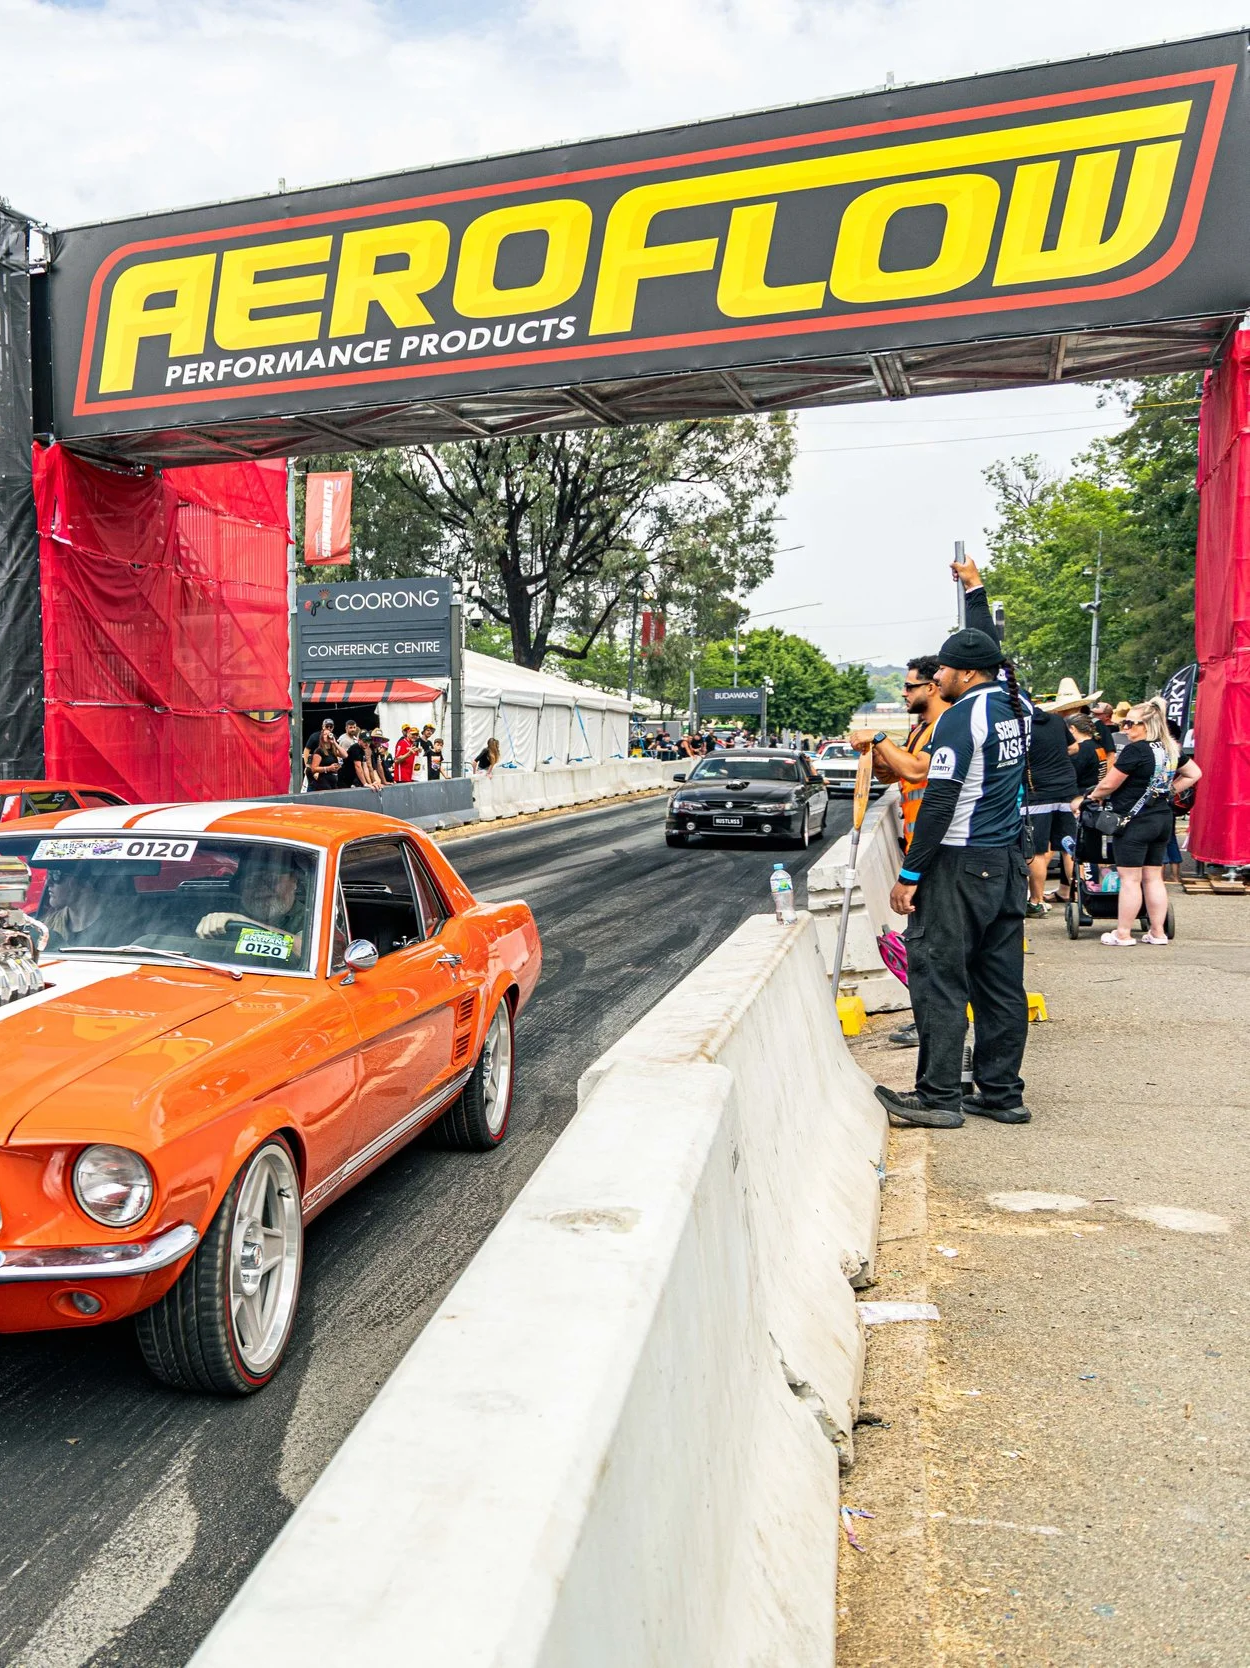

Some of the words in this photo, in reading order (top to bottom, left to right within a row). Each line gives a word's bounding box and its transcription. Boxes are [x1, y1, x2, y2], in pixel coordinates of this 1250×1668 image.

[98, 100, 1193, 393] AEROFLOW
[165, 336, 389, 388] PERFORMANCE
[400, 315, 576, 360] PRODUCTS
[335, 589, 440, 612] COORONG
[308, 642, 389, 658] CONFERENCE
[394, 640, 440, 654] CENTRE
[126, 842, 189, 857] 0120
[245, 943, 282, 956] 0120
